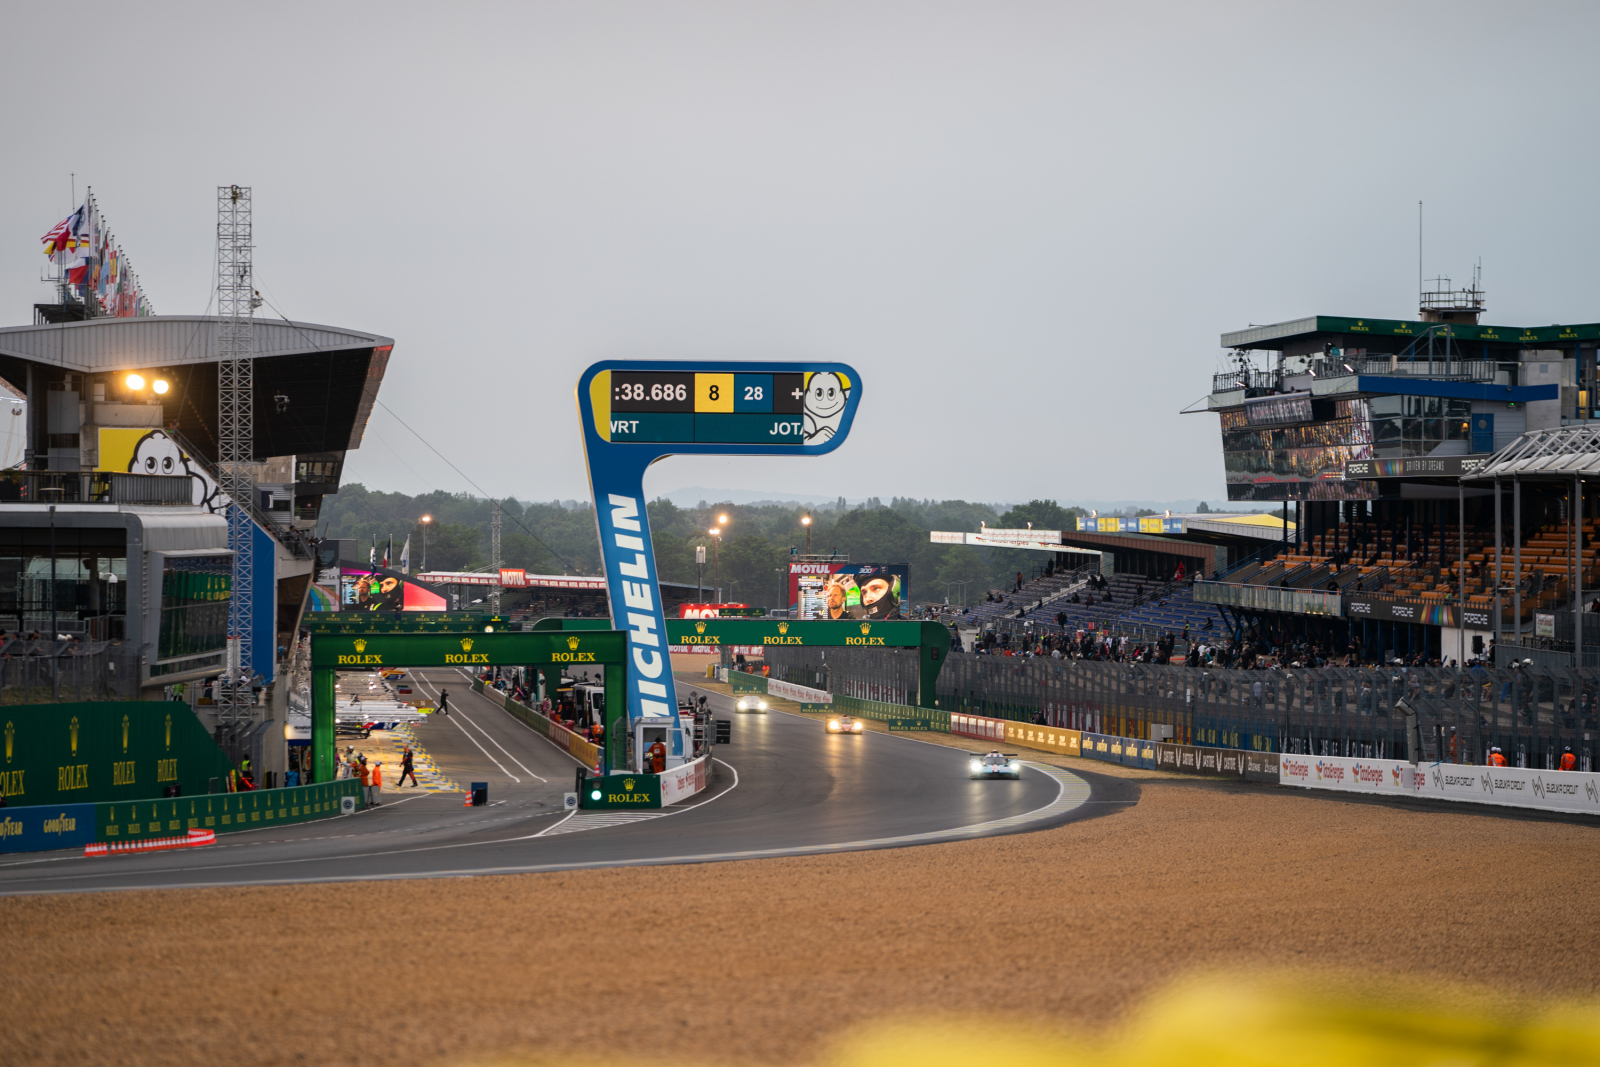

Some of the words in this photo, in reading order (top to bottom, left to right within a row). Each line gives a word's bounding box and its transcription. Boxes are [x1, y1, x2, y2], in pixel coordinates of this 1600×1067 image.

[614, 383, 687, 401] :38.686
[708, 385, 720, 401] 8
[743, 386, 763, 401] 28
[1348, 463, 1369, 474] PORSCHE
[1406, 461, 1420, 471] DRIVEN
[1428, 461, 1444, 471] DREAMS
[790, 564, 830, 574] MOTUL
[501, 571, 526, 586] MOTUL
[608, 494, 669, 718] MICHELIN
[1351, 602, 1371, 614] PORSCHE
[1392, 605, 1414, 617] PORSCHE
[1463, 612, 1488, 625] PORSCHE
[681, 635, 720, 644] ROLEX
[763, 636, 803, 645] ROLEX
[845, 637, 885, 645] ROLEX
[338, 655, 383, 664] ROLEX
[445, 654, 489, 663] ROLEX
[551, 652, 596, 662] ROLEX
[113, 761, 135, 785] ROLEX
[1289, 760, 1308, 781] TotalEnergies
[1322, 762, 1344, 784] TotalEnergies
[1360, 764, 1383, 787] TotalEnergies
[0, 770, 25, 797] OLEX
[58, 764, 88, 791] ROLEX
[608, 793, 650, 803] ROLEX
[43, 812, 76, 836] GOODYEAR
